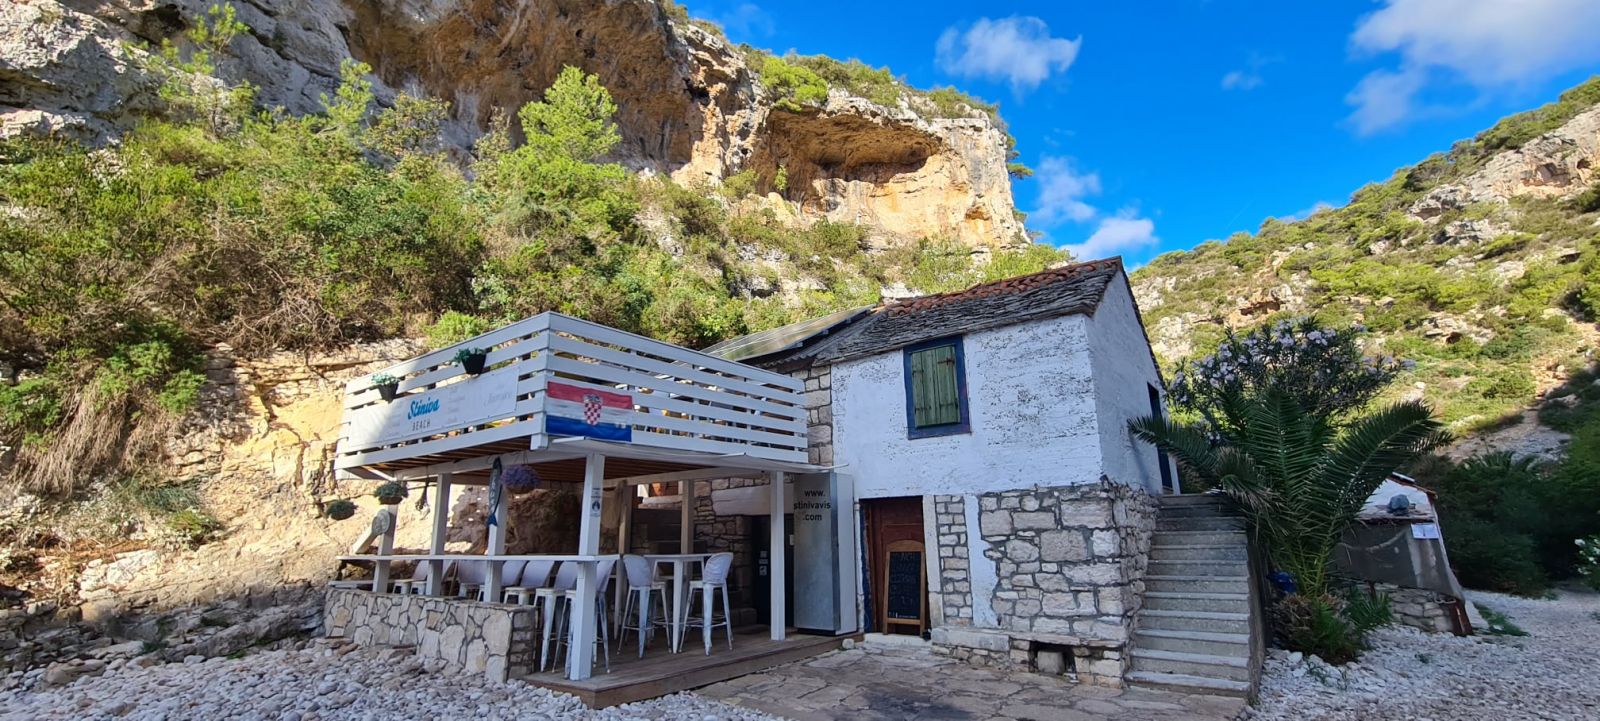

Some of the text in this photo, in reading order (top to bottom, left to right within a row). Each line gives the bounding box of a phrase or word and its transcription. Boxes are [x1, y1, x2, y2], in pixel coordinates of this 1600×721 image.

[408, 397, 440, 420] Stiniva
[412, 419, 431, 431] BEACH
[794, 501, 831, 510] stinivavis
